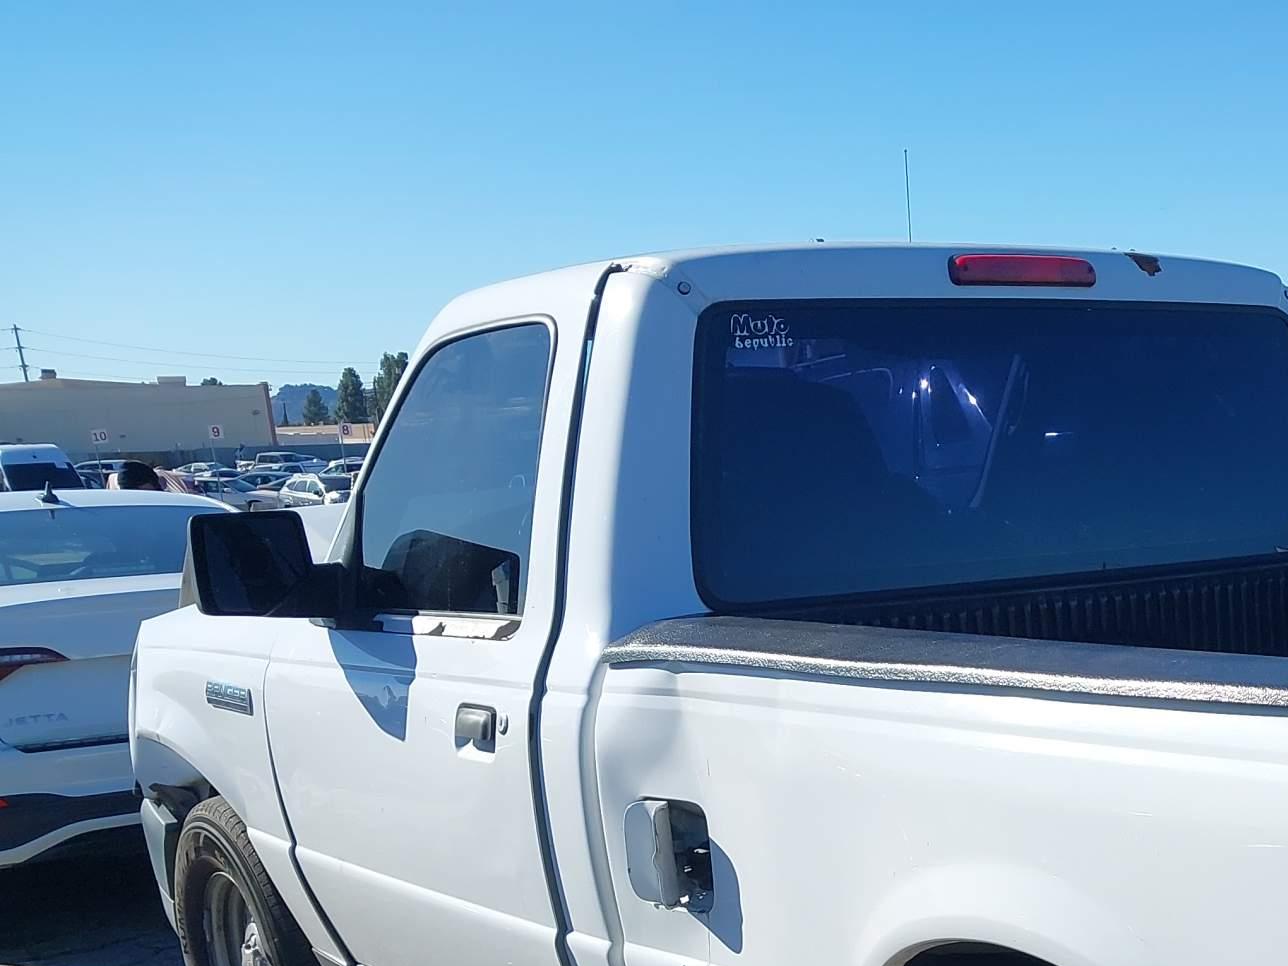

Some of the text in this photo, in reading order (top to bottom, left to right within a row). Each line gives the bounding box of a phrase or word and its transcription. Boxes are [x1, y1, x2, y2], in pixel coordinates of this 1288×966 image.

[211, 426, 221, 437] 9
[341, 424, 350, 436] 8
[93, 431, 108, 442] 10
[4, 712, 69, 728] JETTA
